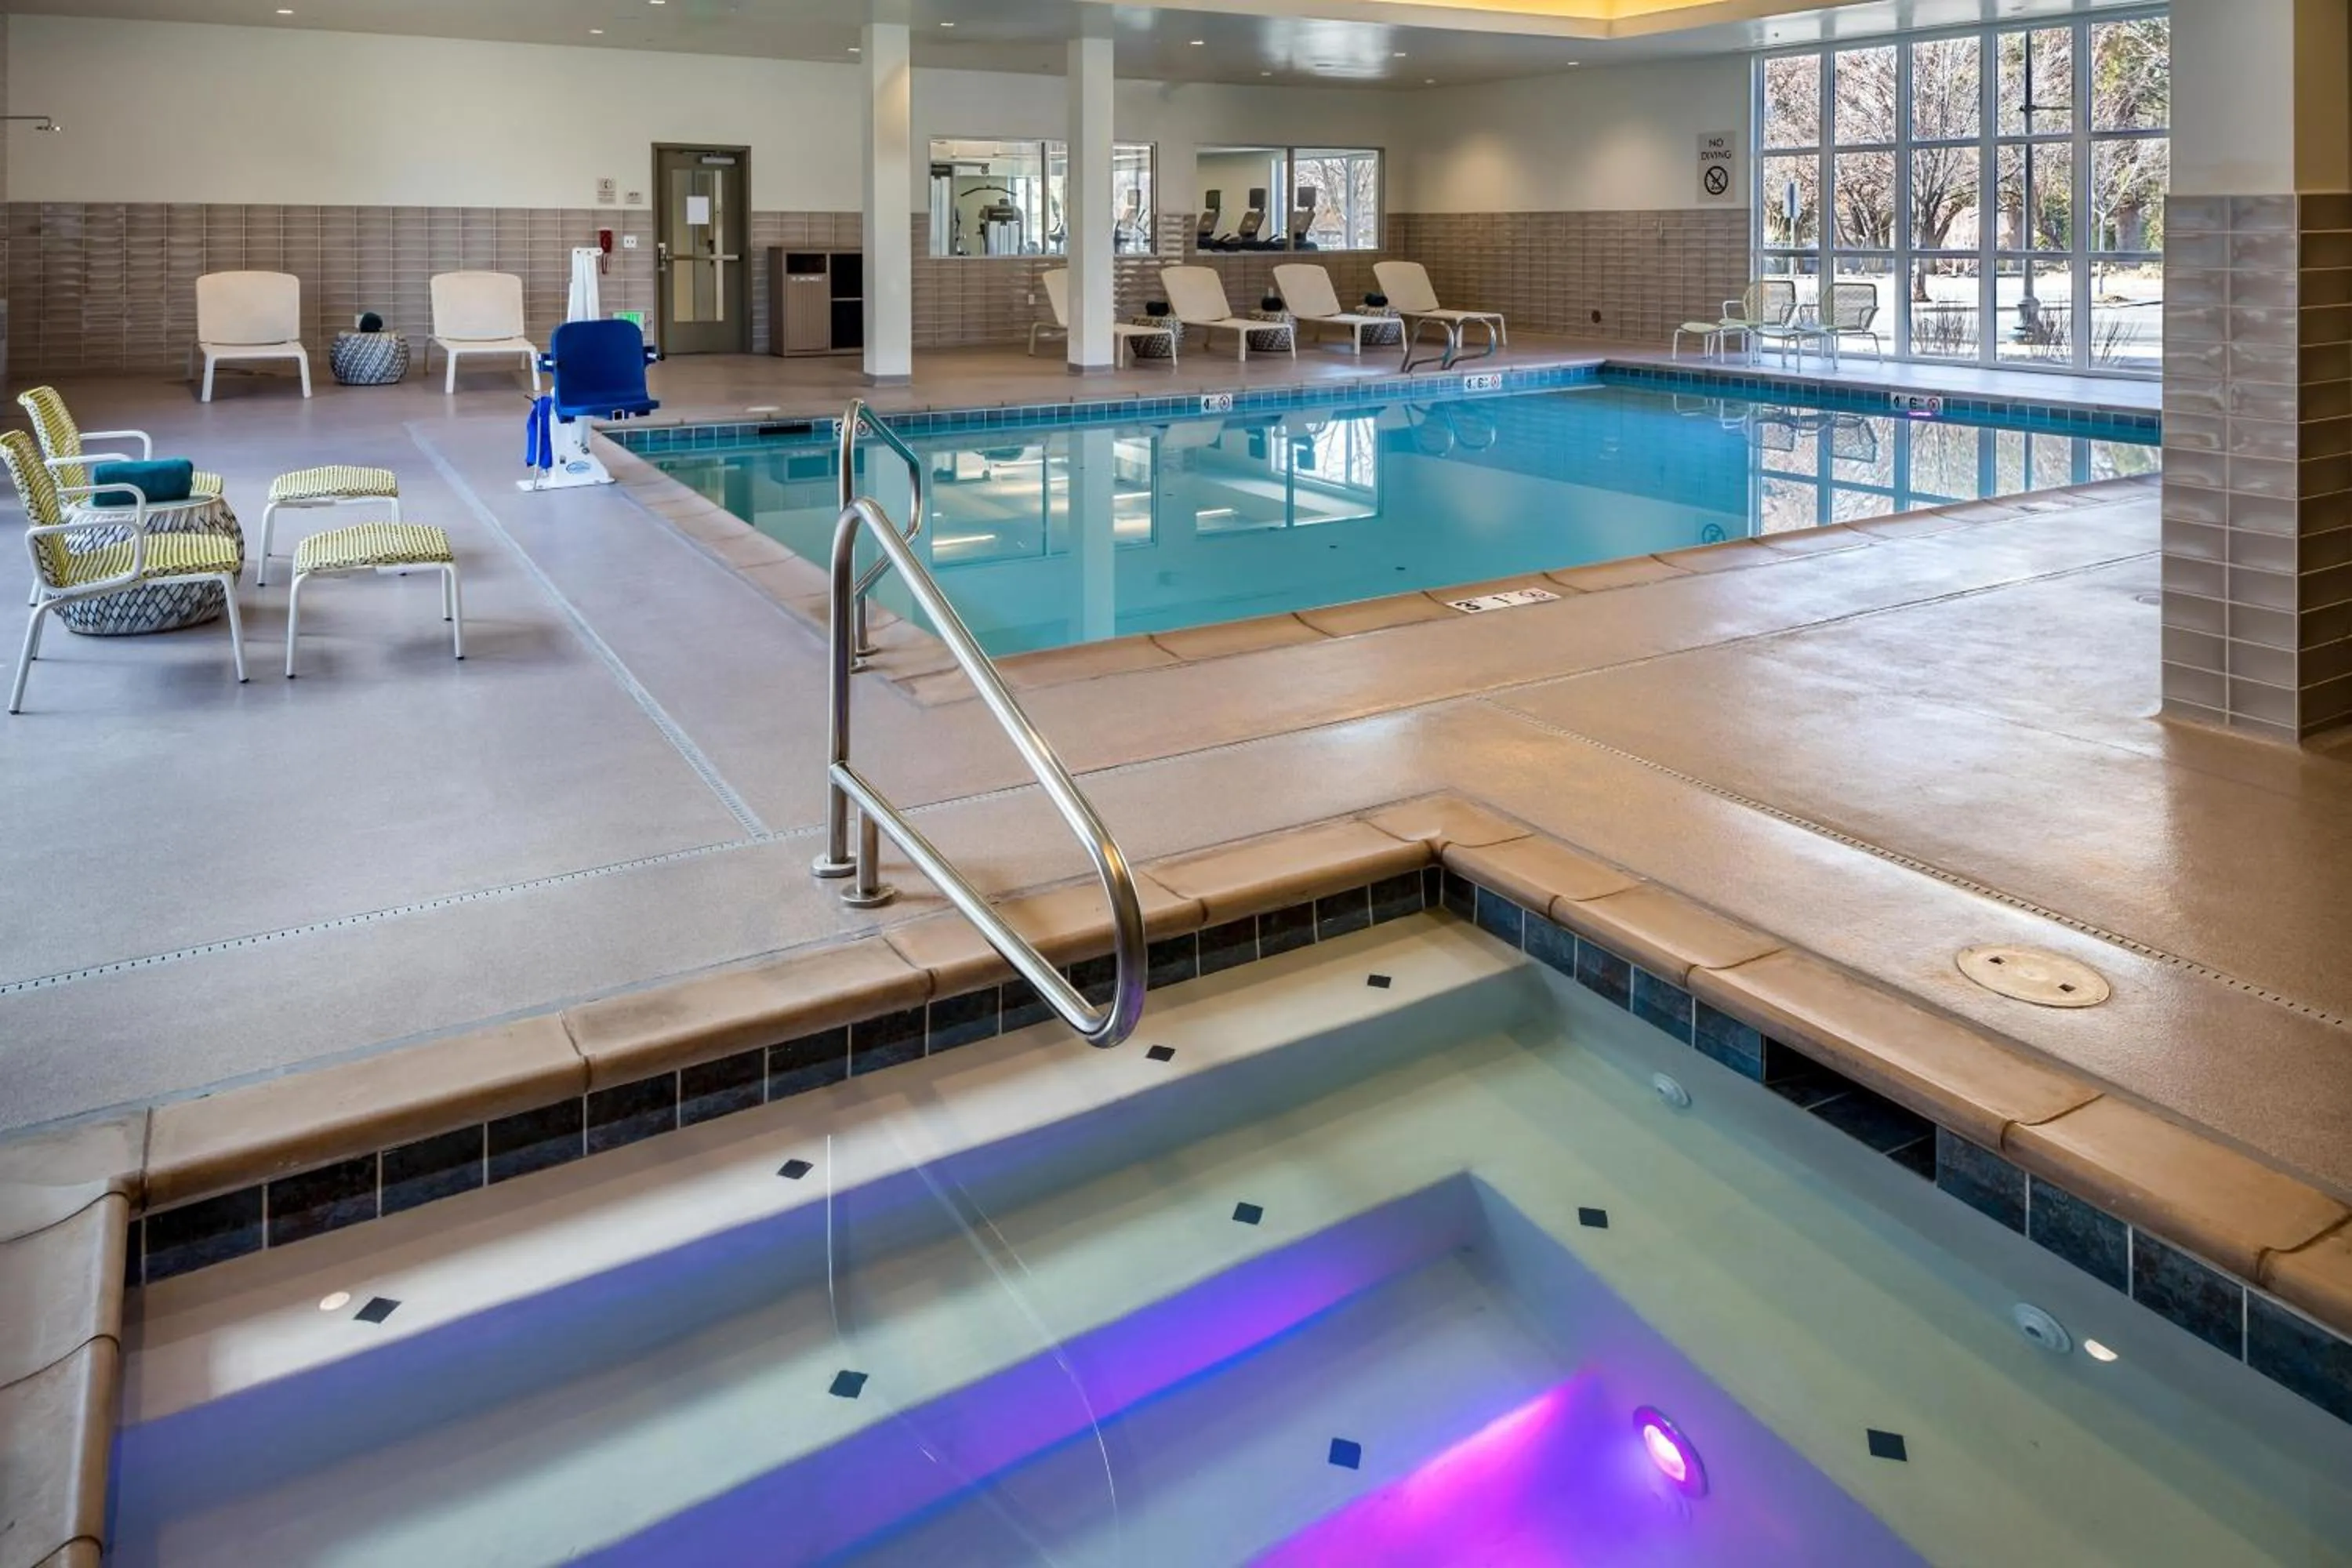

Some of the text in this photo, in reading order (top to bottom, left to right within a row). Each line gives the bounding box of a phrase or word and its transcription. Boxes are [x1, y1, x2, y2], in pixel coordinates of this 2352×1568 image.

[1708, 137, 1724, 148] NO
[1700, 150, 1732, 161] DIVING
[1454, 601, 1482, 611] 3
